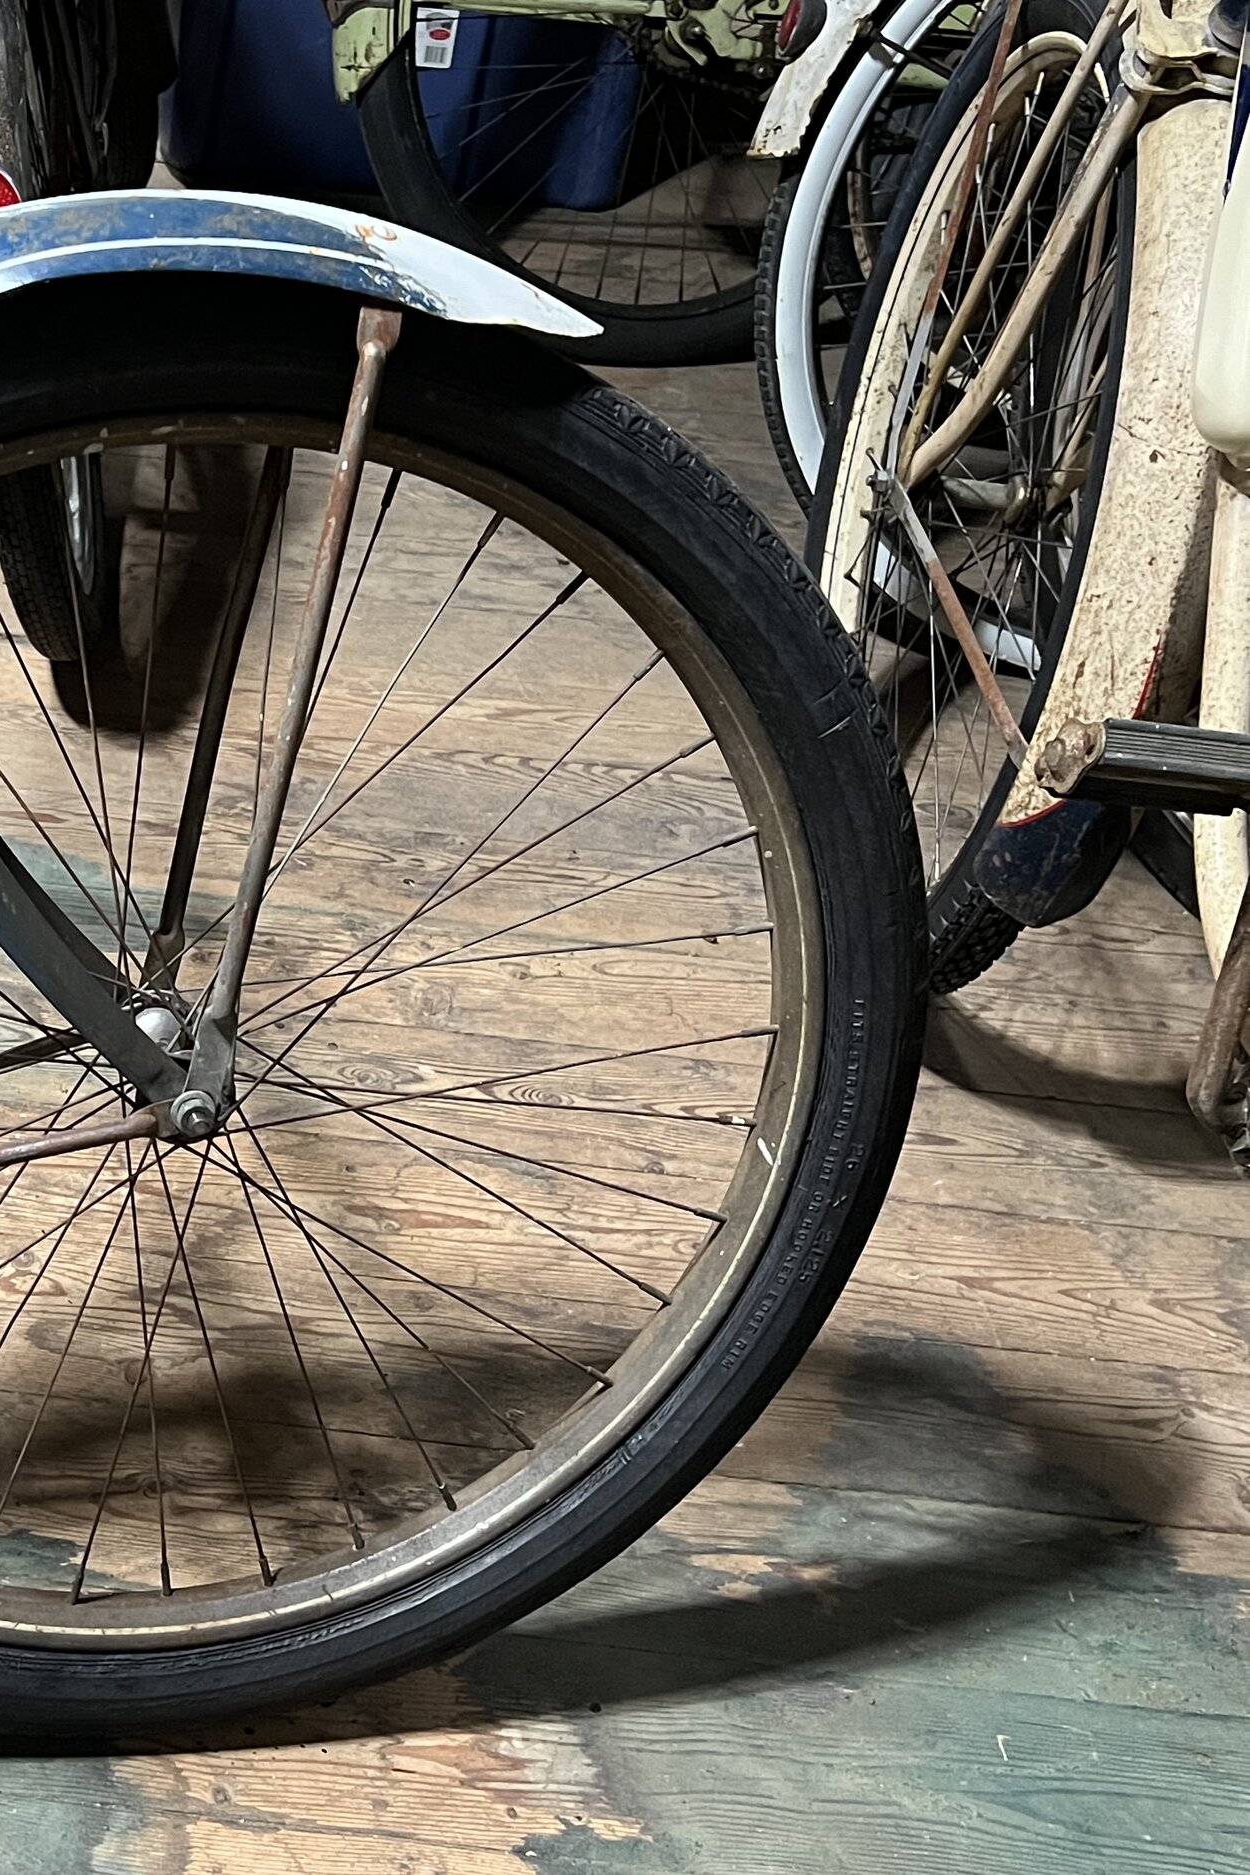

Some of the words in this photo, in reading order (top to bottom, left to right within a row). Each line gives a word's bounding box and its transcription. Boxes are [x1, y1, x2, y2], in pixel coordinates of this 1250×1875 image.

[851, 998, 865, 1043] FITS
[833, 1051, 860, 1142] STRAIGHT
[845, 1142, 866, 1170] 26
[808, 1191, 824, 1213] OR
[776, 1218, 813, 1286] HOOKED
[748, 1291, 779, 1336] EDGE
[721, 1339, 748, 1371] RIM
